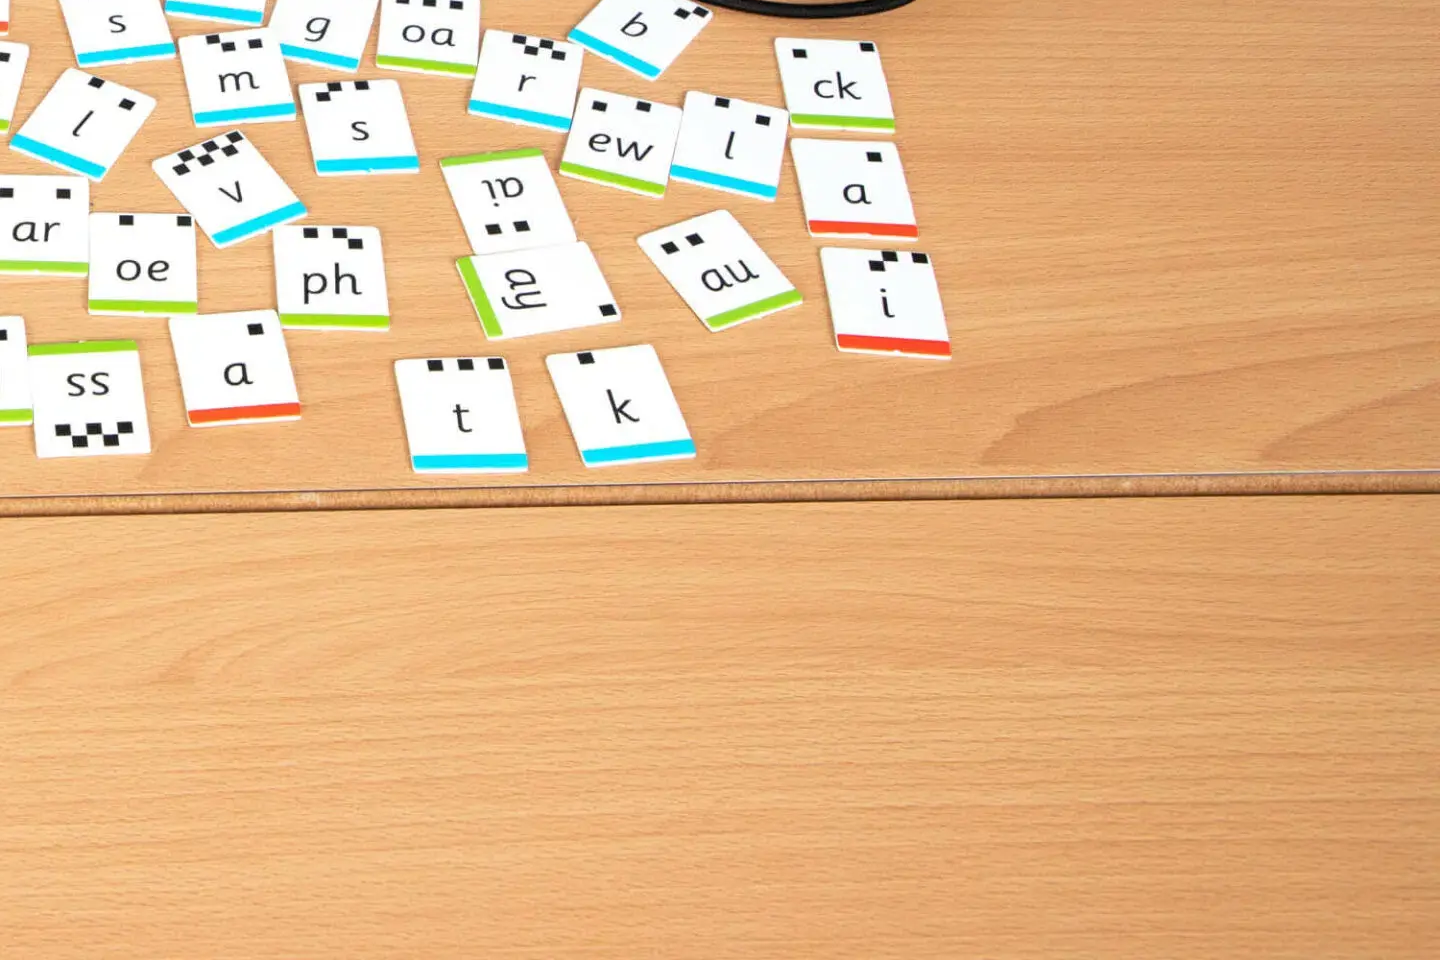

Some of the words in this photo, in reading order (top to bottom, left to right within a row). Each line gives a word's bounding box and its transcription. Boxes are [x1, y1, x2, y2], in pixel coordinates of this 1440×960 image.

[108, 14, 127, 33] s
[304, 17, 331, 42] g
[402, 24, 456, 47] oa
[620, 11, 648, 37] b
[218, 71, 260, 93] m
[518, 74, 537, 92] r
[813, 71, 862, 100] ck
[351, 121, 370, 141] s
[588, 133, 654, 162] ew
[218, 180, 243, 203] v
[481, 176, 524, 207] ai
[842, 183, 872, 205] a
[12, 221, 61, 242] ar
[116, 259, 170, 282] oe
[701, 259, 760, 292] au
[303, 262, 362, 305] ph
[501, 268, 547, 310] ay
[880, 288, 895, 318] i
[66, 372, 110, 397] ss
[223, 362, 254, 386] a
[452, 404, 473, 433] t
[606, 388, 640, 424] k
